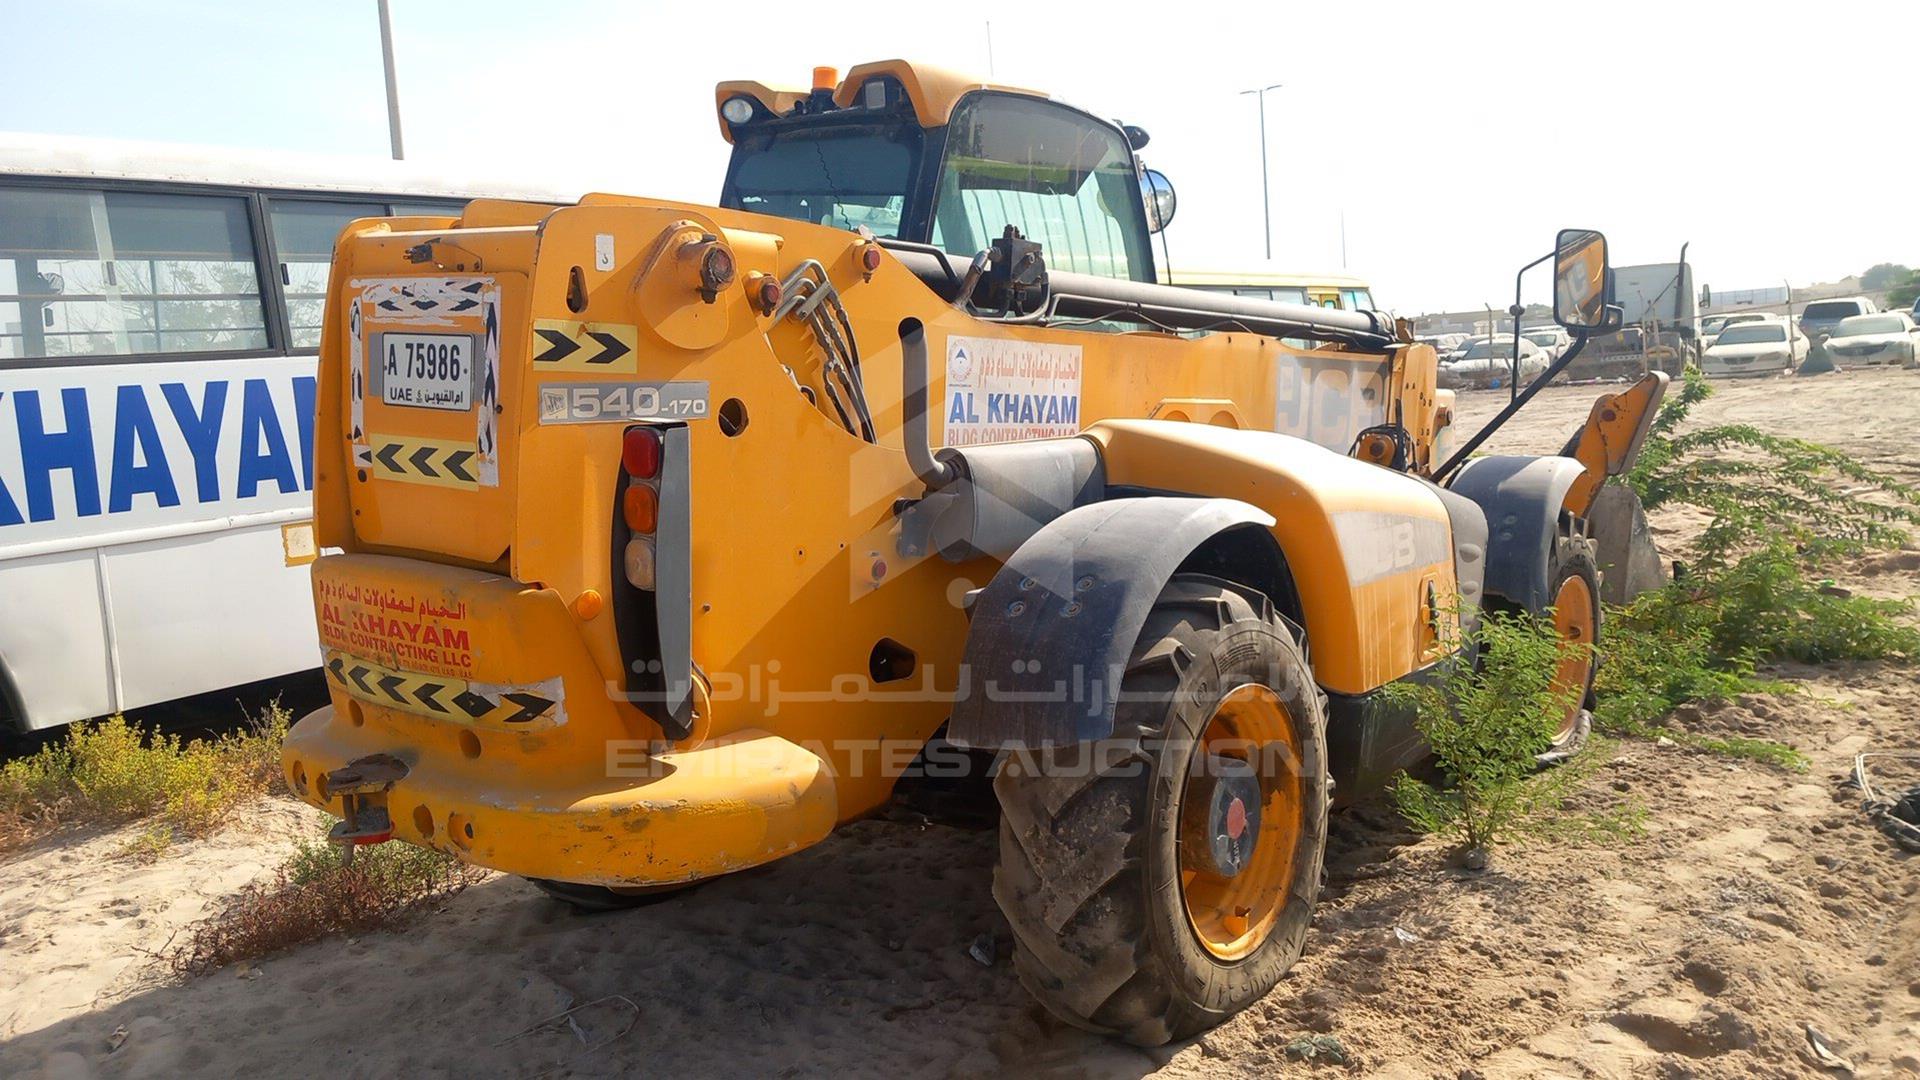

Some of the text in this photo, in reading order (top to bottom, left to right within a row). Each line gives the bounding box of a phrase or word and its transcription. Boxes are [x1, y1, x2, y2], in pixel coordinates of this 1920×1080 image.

[387, 342, 460, 382] A 75986
[389, 386, 413, 402] UAE
[949, 392, 1077, 424] AL KHAYAM
[0, 375, 316, 527] HAYA
[948, 428, 978, 447] BLDG
[322, 603, 470, 651] AL KHAYAM
[350, 631, 439, 664] CONTRACTING
[442, 650, 472, 668] LLC
